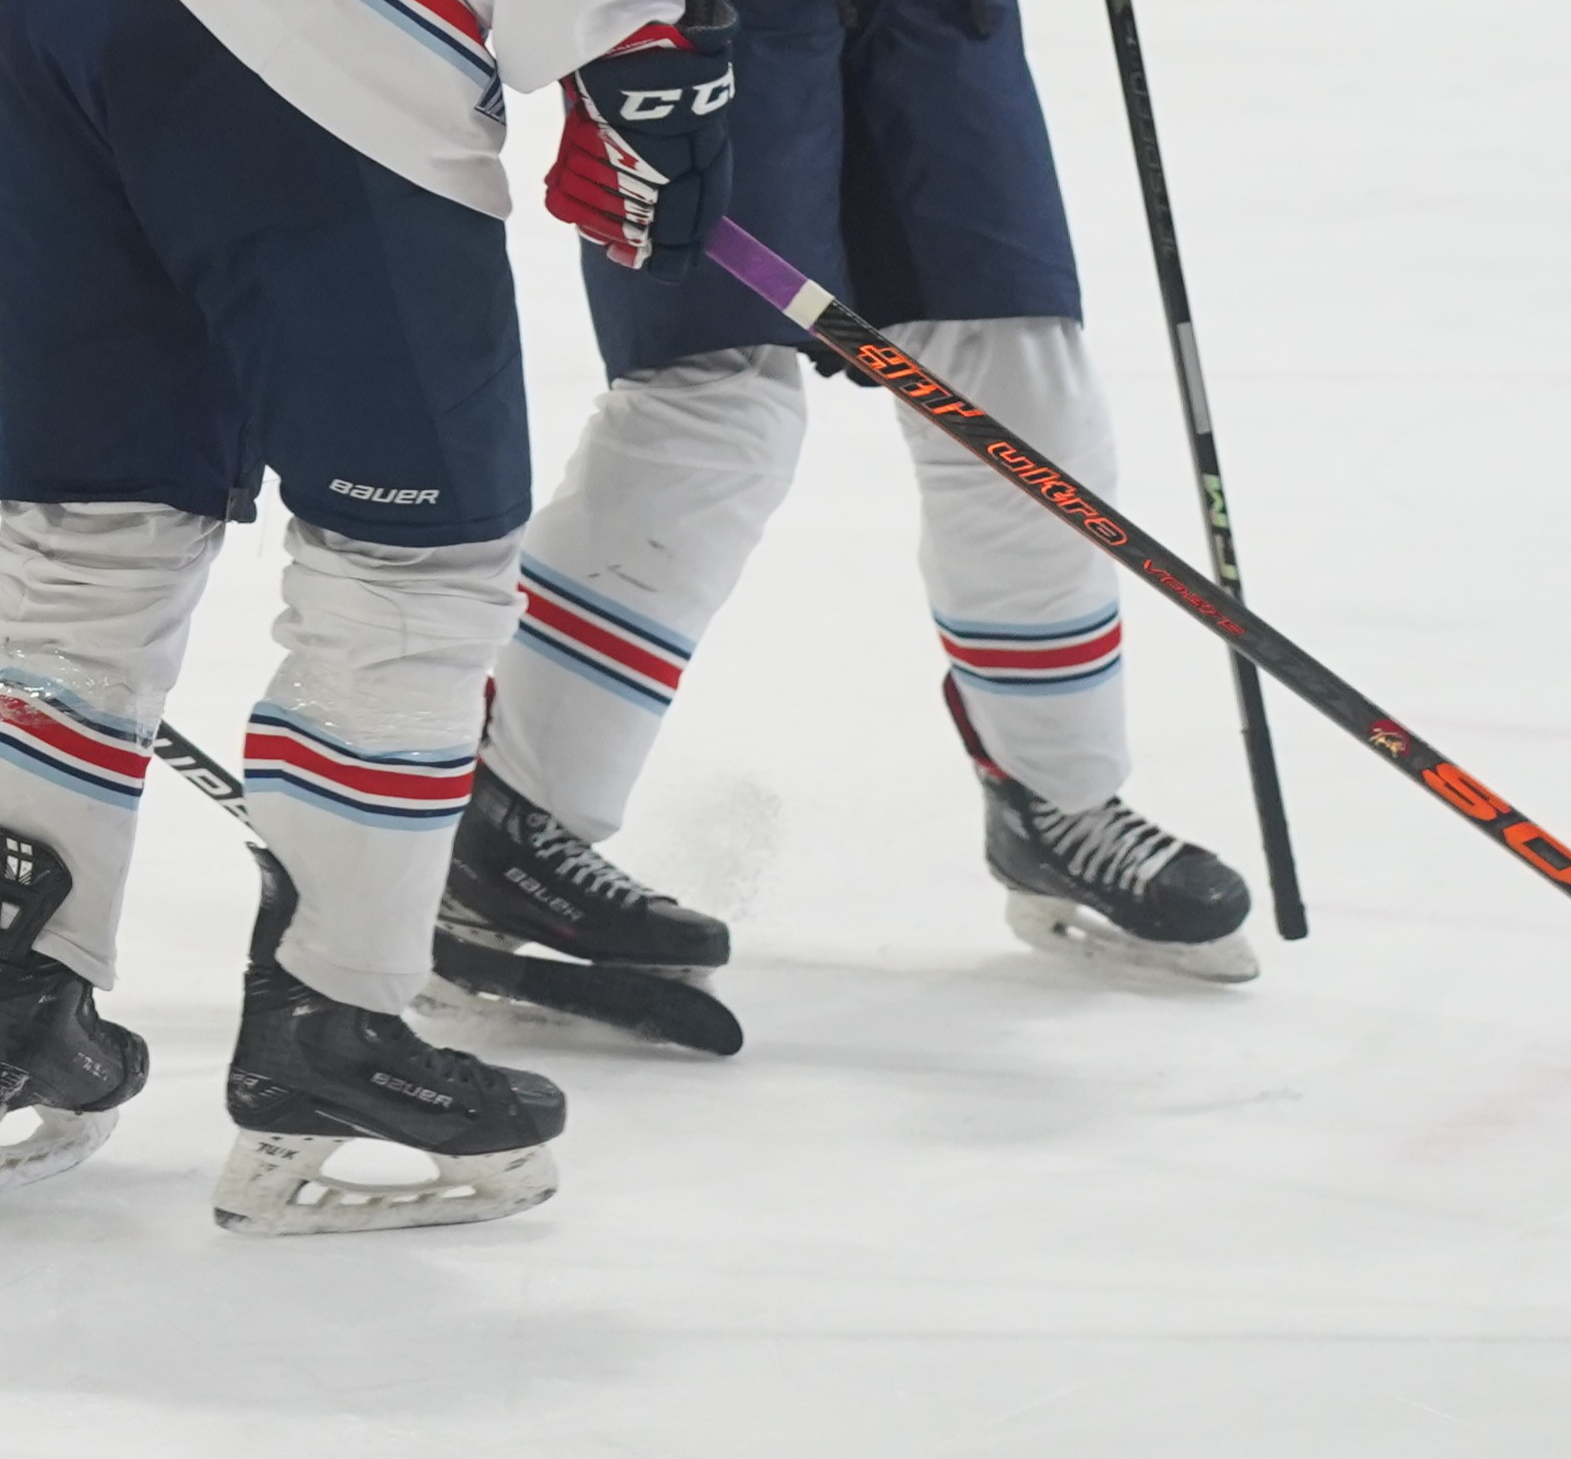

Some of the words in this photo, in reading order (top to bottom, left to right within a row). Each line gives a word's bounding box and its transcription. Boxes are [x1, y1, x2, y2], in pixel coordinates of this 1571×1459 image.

[619, 61, 736, 121] CC
[328, 477, 441, 507] BAUER
[369, 1071, 454, 1109] BAUER
